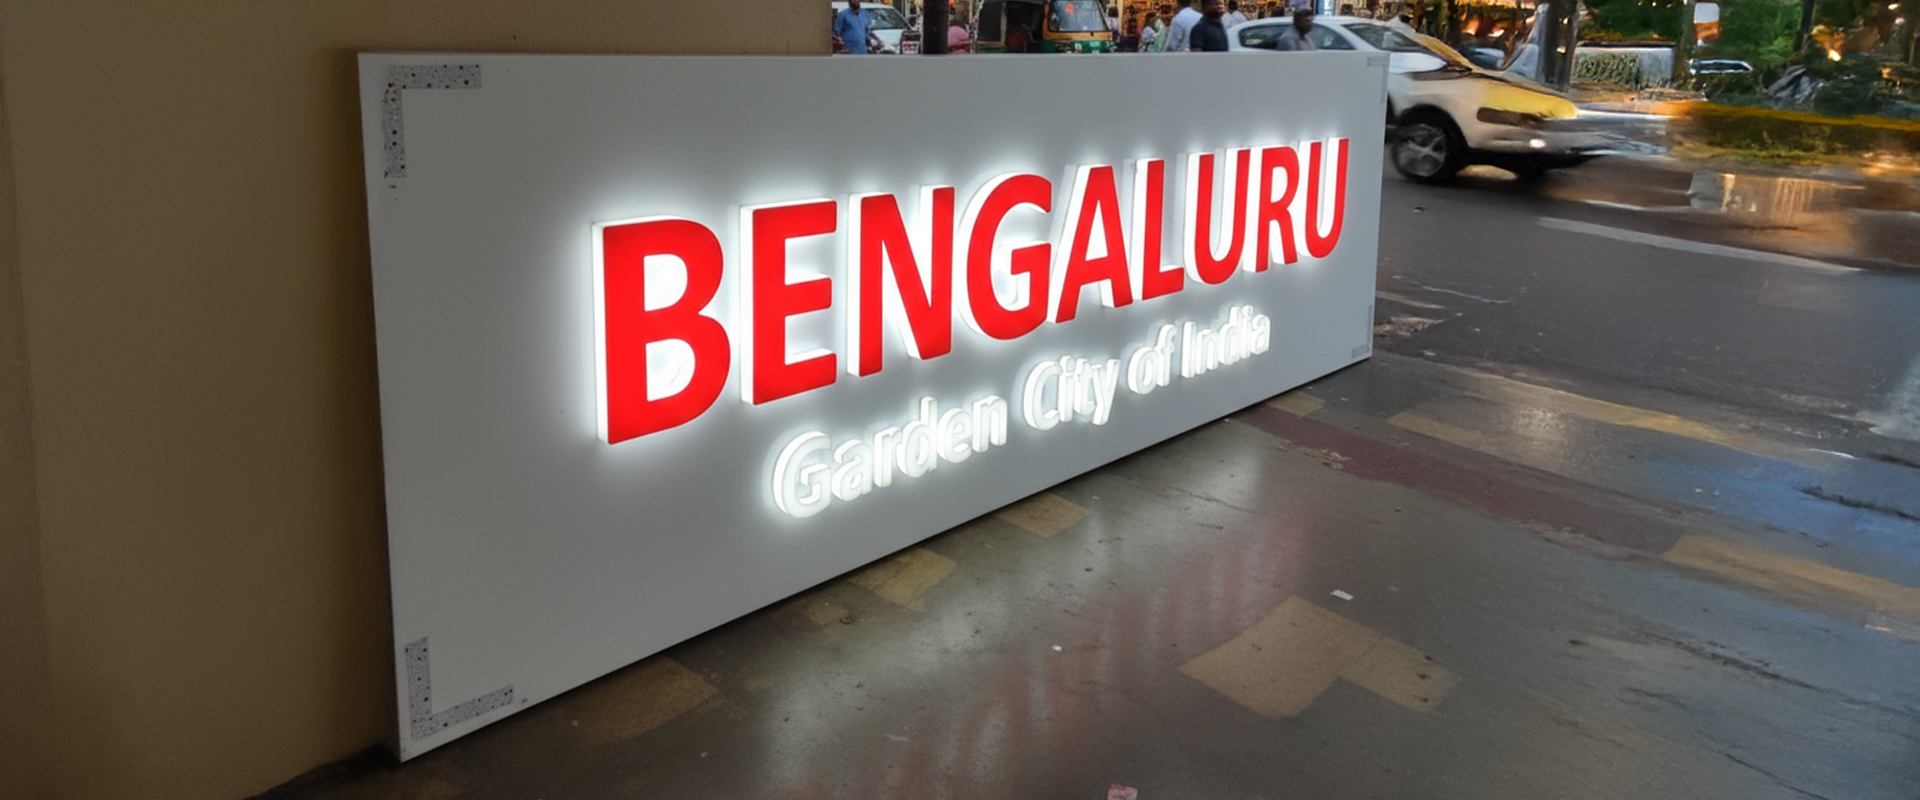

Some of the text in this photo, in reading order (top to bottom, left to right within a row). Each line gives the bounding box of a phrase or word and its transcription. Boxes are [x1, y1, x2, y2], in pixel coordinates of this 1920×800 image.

[594, 137, 1349, 444] BENGALURU
[773, 305, 1271, 518] Garden City of India
